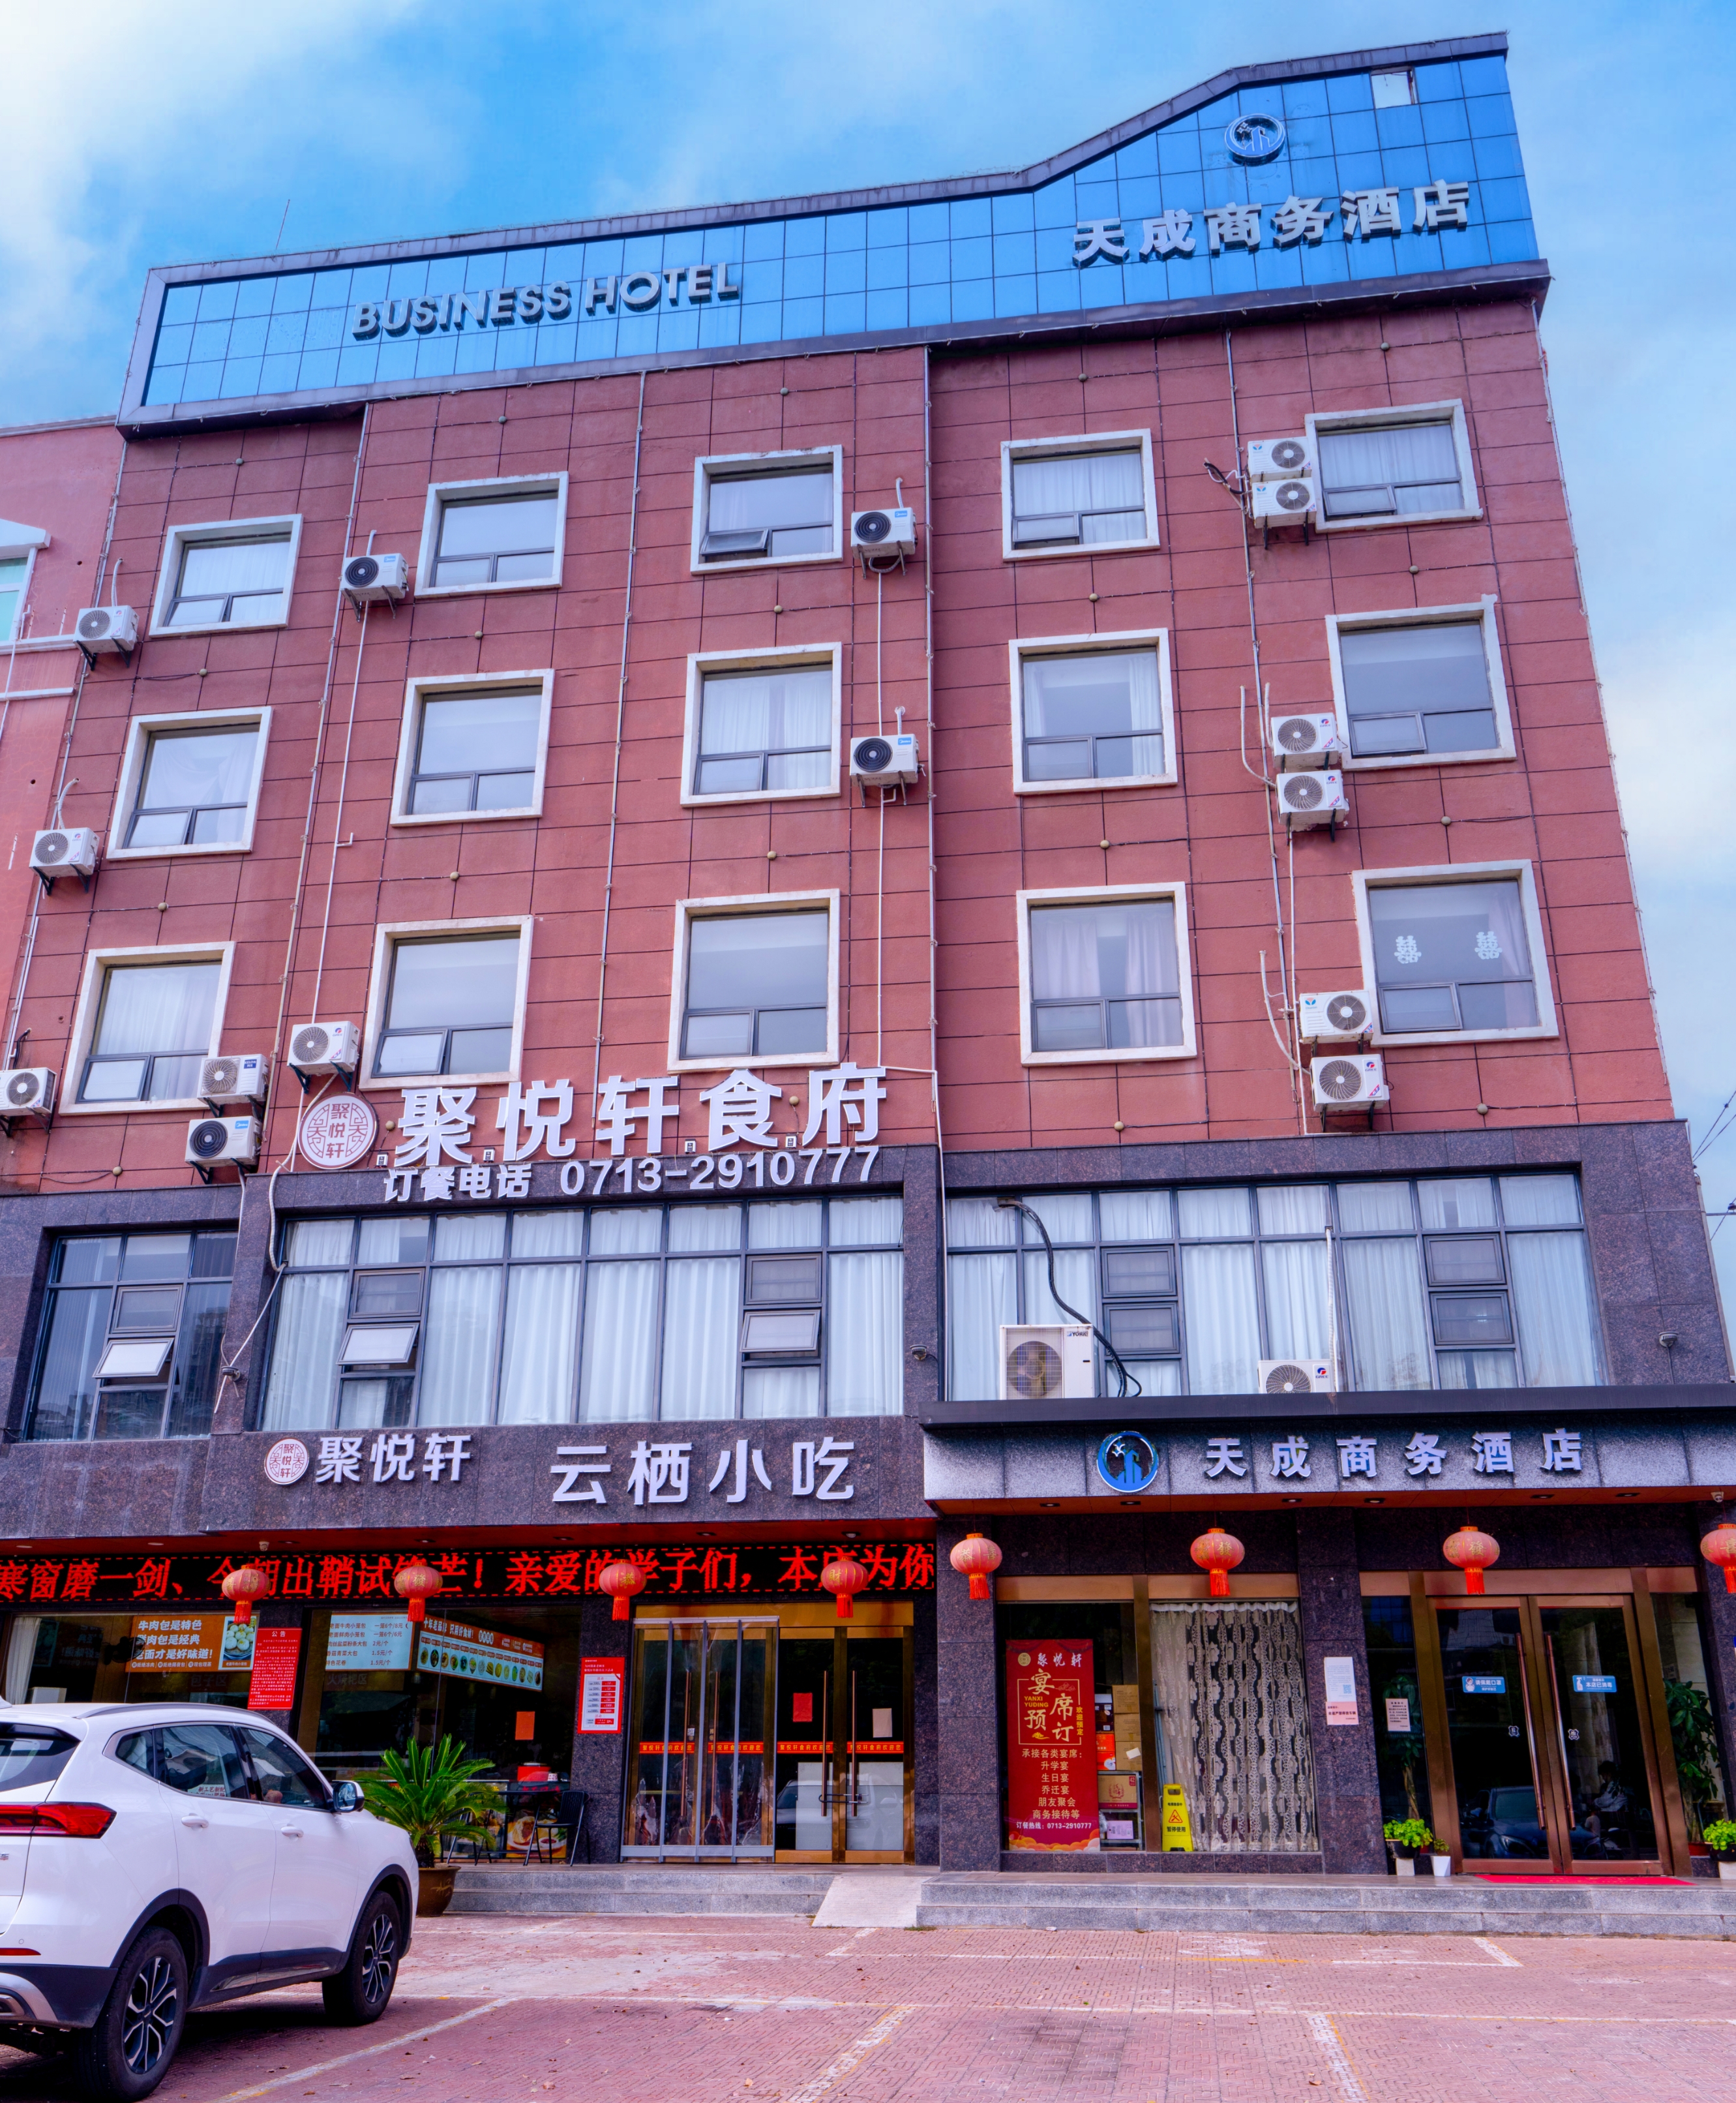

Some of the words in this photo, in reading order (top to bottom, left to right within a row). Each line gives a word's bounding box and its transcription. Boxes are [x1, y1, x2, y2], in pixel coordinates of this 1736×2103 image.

[1072, 179, 1470, 269] 天成商务酒店
[352, 281, 573, 339] BUSINESS
[585, 262, 739, 314] HOTEL
[326, 1103, 350, 1158] 聚悦轩
[395, 1063, 887, 1165] 聚悦轩食府
[383, 1164, 533, 1202] 订餐电话
[560, 1146, 880, 1196] 0713-2910777
[281, 1444, 295, 1479] 聚悦轩
[316, 1434, 472, 1483] 聚悦轩
[552, 1437, 856, 1504] 云栖小吃
[1206, 1429, 1583, 1478] 天成商务酒店
[138, 1620, 202, 1631] 牛肉包是特色
[1038, 1652, 1082, 1667] 聚悦轩
[1022, 1749, 1083, 1758] 承接各类宴席：
[1041, 1761, 1069, 1770] 升学宴
[1041, 1773, 1070, 1782] 生日宴
[1041, 1785, 1070, 1794] 乔迁宴
[1032, 1809, 1080, 1819] 商务接待等
[1038, 1797, 1076, 1807] 朋友聚会
